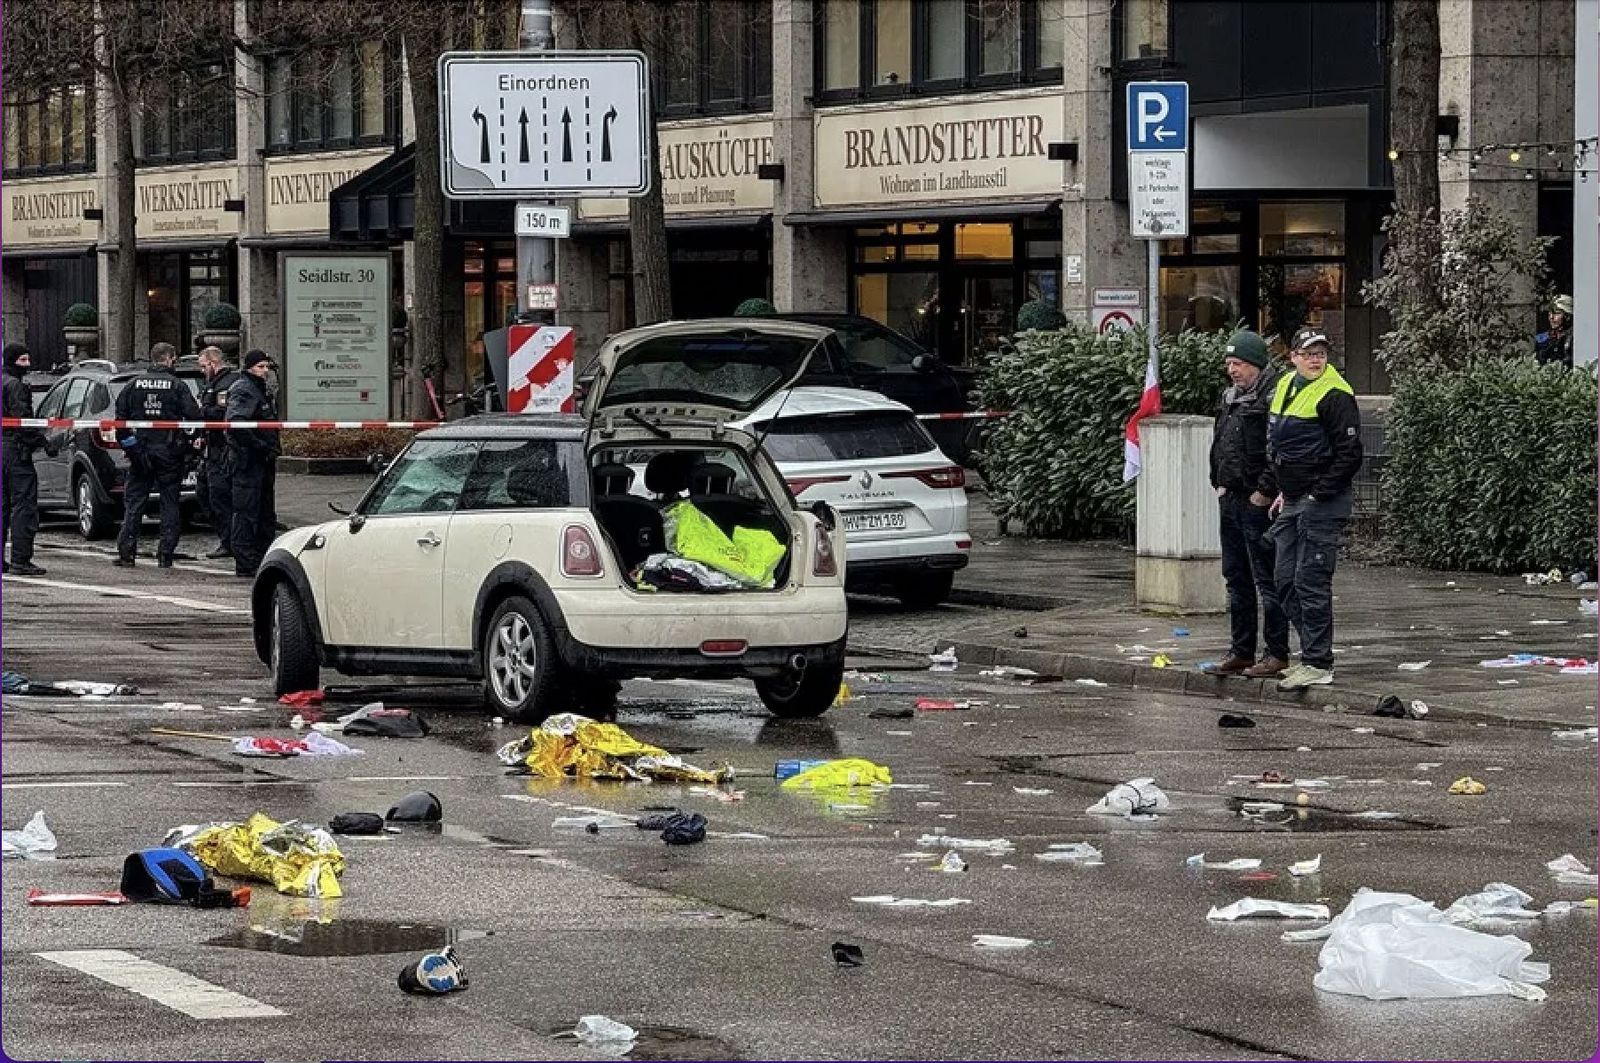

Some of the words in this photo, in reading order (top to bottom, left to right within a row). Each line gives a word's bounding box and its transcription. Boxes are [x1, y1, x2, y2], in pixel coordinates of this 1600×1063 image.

[498, 74, 590, 91] Einordnen
[1138, 91, 1170, 143] P
[660, 129, 773, 180] AUSKÜCHE
[844, 115, 1046, 169] BRANDSTETTER
[139, 174, 232, 213] WERKSTÄTTEN
[879, 173, 921, 194] Wohnen
[922, 172, 938, 191] im
[939, 167, 1007, 191] Landhausstil
[12, 189, 95, 221] BRANDSTETTER
[526, 212, 547, 229] 150
[549, 216, 560, 229] m
[299, 268, 353, 283] Seidlstr.
[357, 268, 375, 283] 30
[136, 379, 171, 390] POLIZEI
[840, 491, 895, 499] TALISMAN
